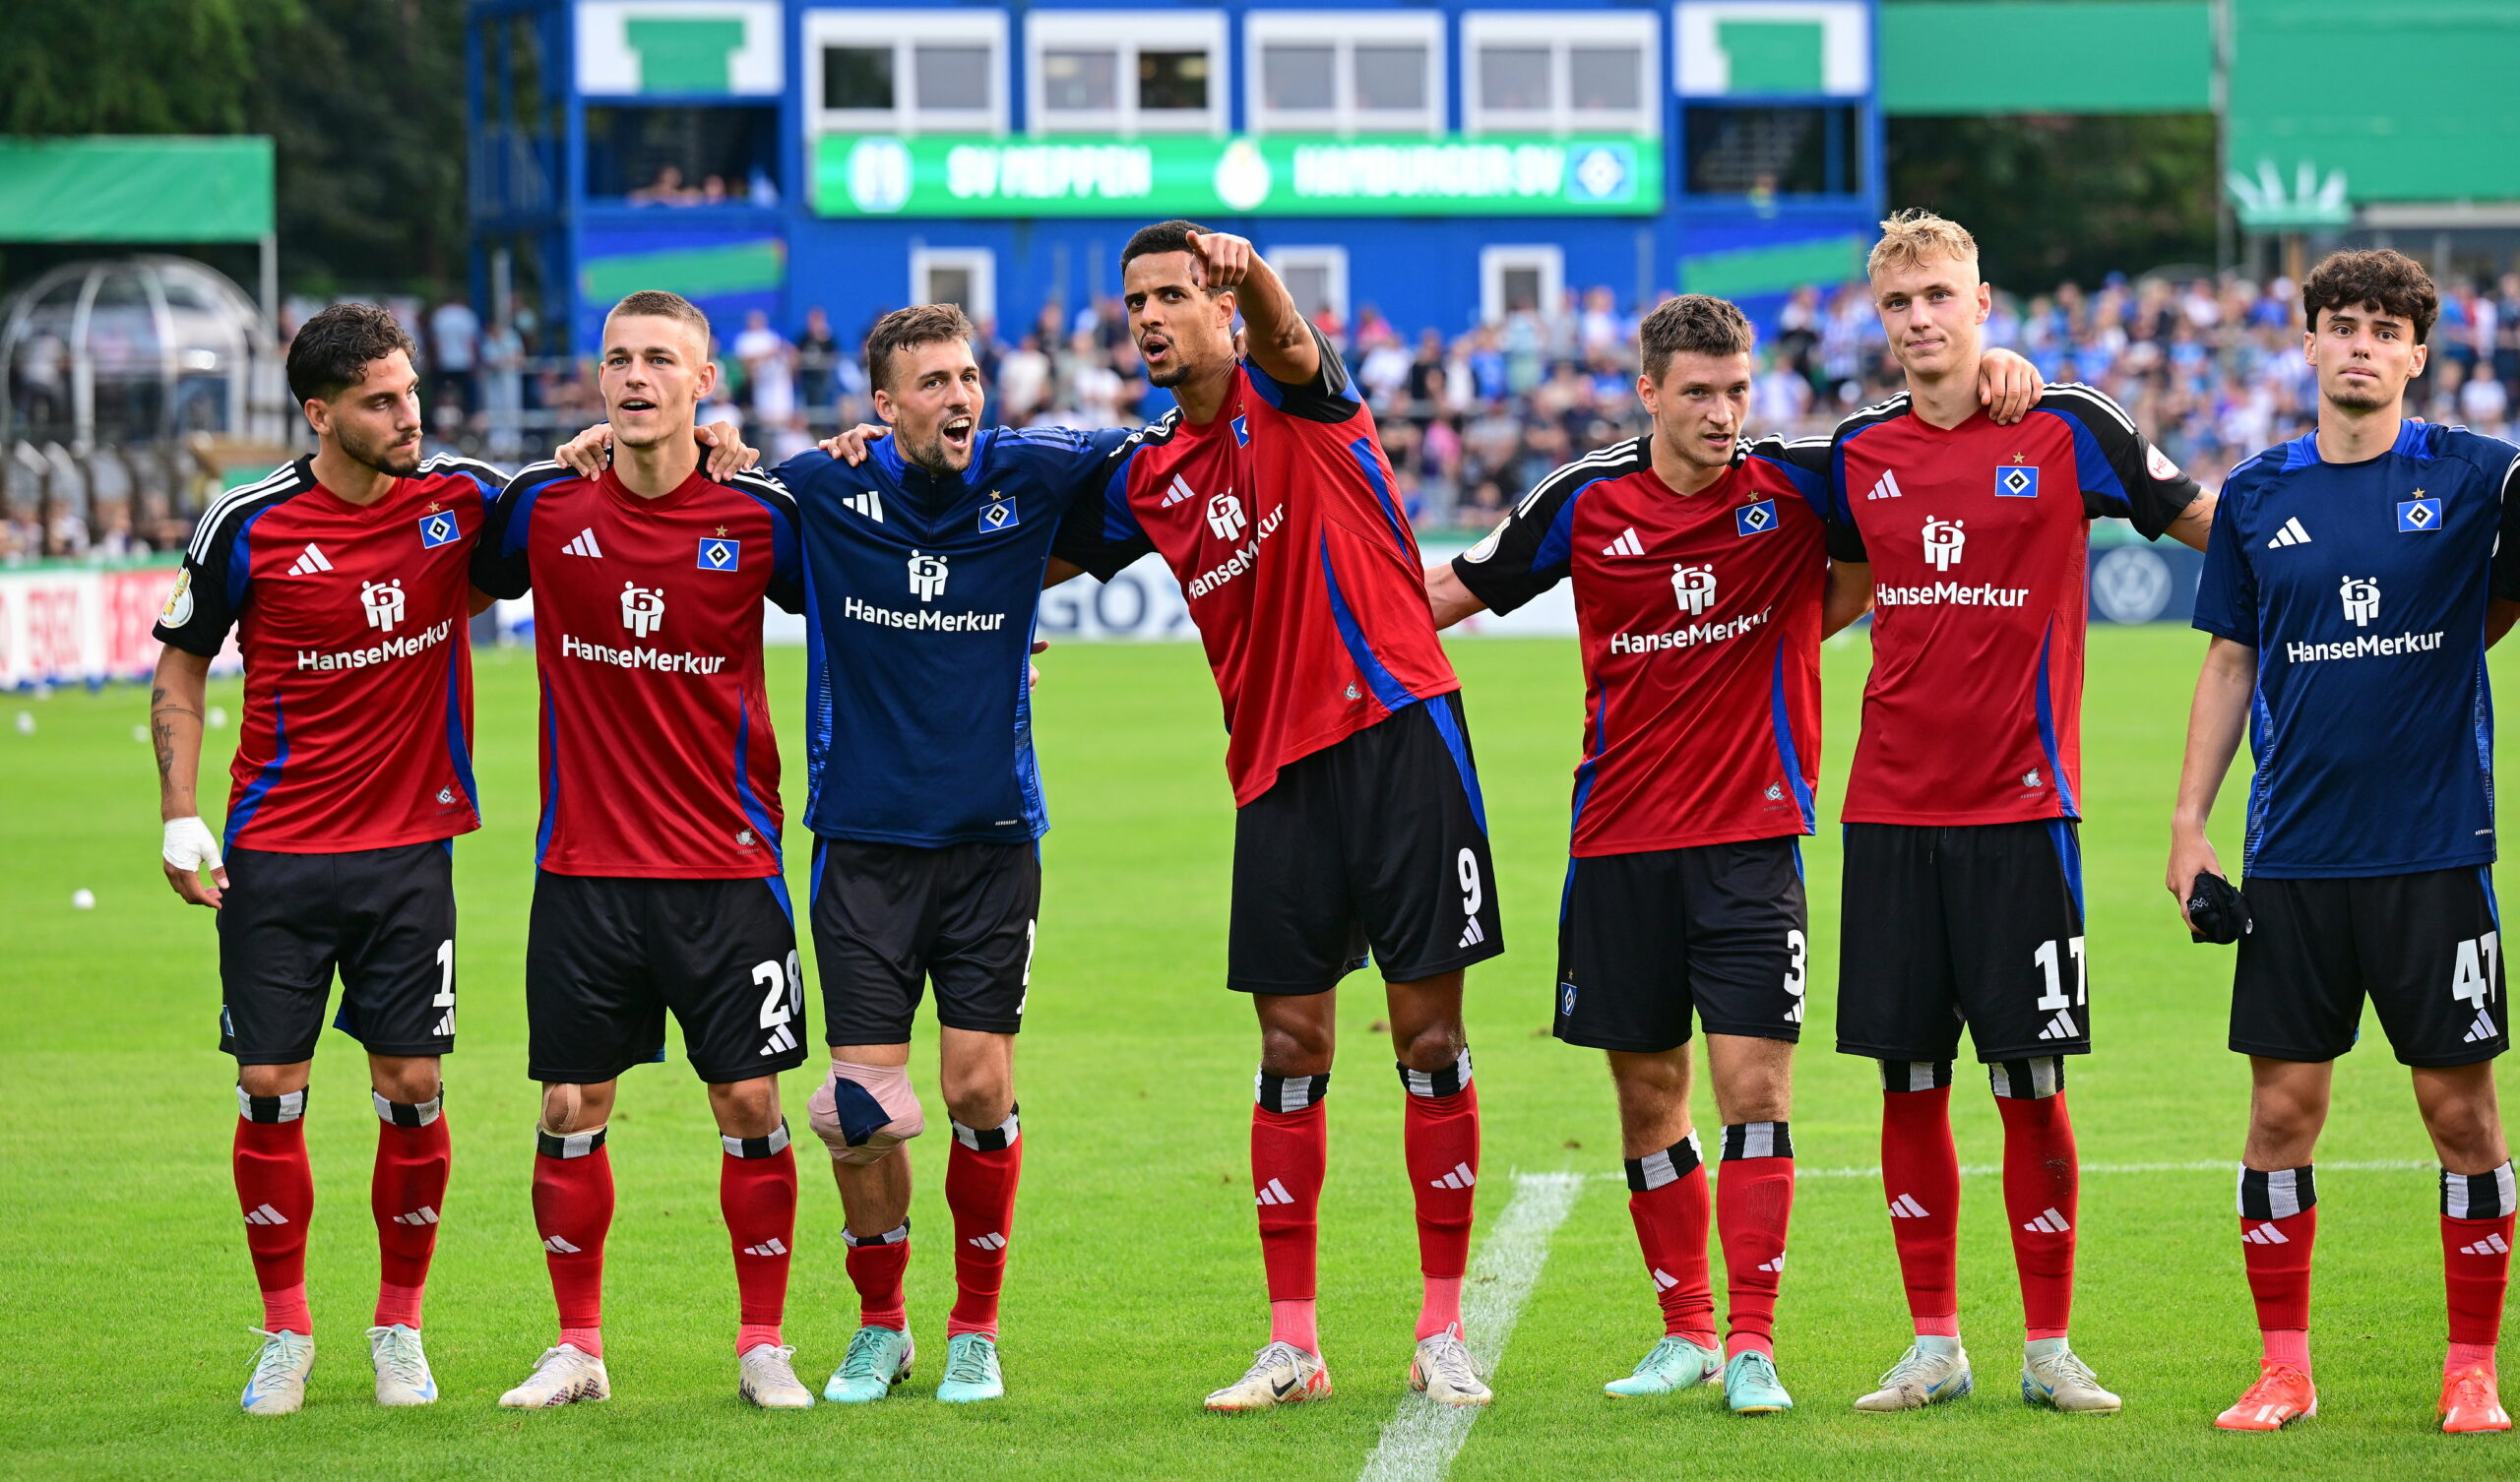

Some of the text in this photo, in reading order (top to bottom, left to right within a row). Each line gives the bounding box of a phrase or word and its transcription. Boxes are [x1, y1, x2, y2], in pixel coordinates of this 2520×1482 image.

[947, 145, 998, 198] SV
[1293, 145, 1563, 197] HAMBURGER SV
[1188, 502, 1285, 599] HanseMkur
[845, 596, 1005, 632] HanseMerkur
[1876, 582, 2029, 607] HanseMerkur
[297, 617, 454, 671] HanseMerkur
[562, 633, 725, 675] HanseMerkur
[1610, 605, 1772, 654] HanseMerkur
[2287, 631, 2444, 663] HanseMerkur
[1458, 847, 1482, 915] 9
[432, 939, 455, 1008] 1
[751, 949, 802, 1029] 28
[1784, 929, 1806, 997] 3
[2034, 936, 2086, 1012] 17
[2452, 930, 2498, 1010] 47
